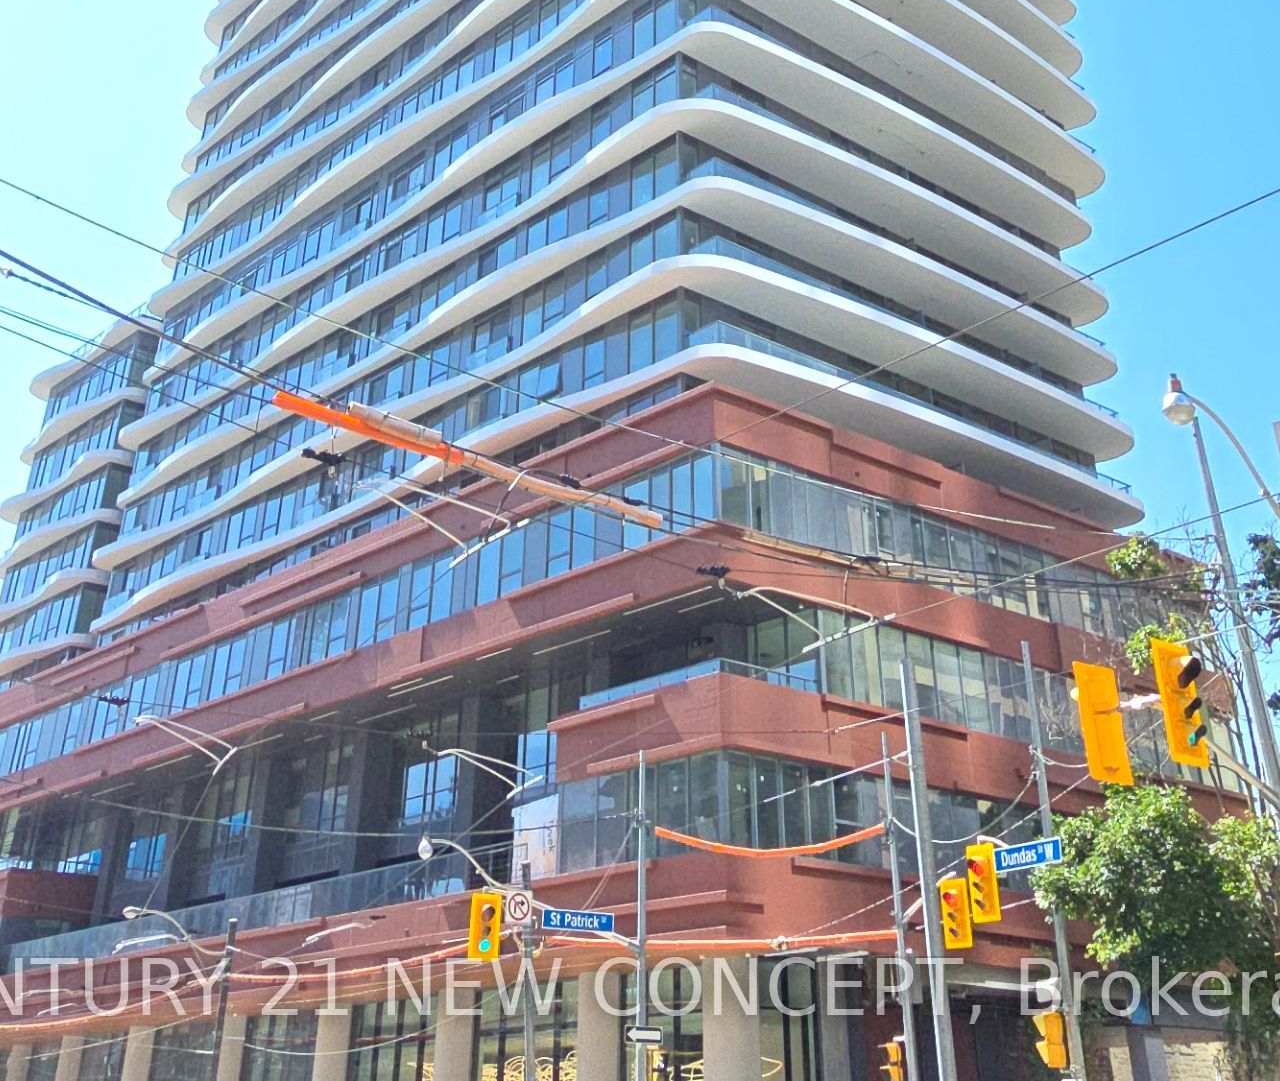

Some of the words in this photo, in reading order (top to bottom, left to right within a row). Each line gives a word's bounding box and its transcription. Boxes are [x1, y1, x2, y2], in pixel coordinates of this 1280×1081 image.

[1001, 847, 1037, 867] Dundas
[1044, 842, 1054, 860] W
[550, 912, 561, 926] St
[565, 913, 599, 928] Patrick
